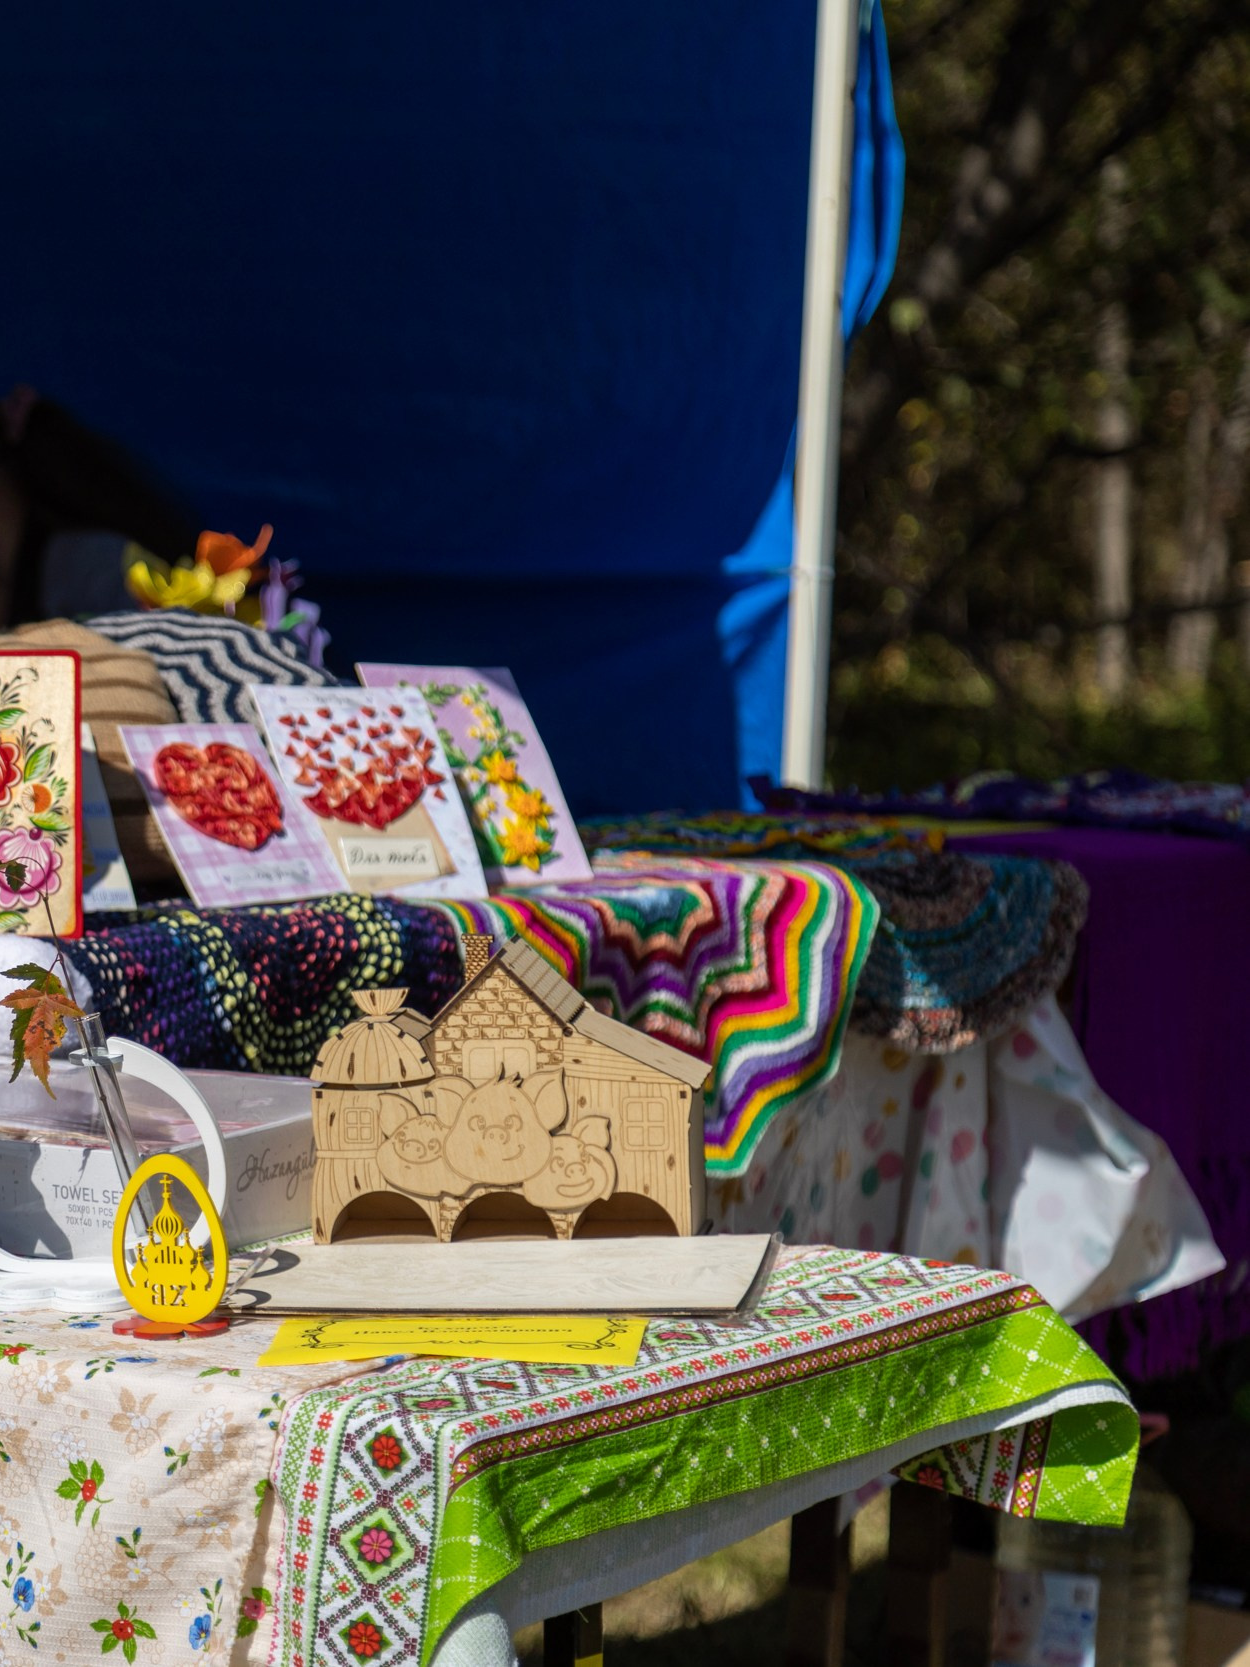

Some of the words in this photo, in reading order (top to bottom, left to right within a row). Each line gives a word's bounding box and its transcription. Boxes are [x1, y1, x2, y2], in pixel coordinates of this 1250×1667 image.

[236, 1136, 317, 1201] Hazangül
[52, 1184, 99, 1203] TOWEL
[98, 1207, 114, 1217] PCS
[102, 1219, 115, 1230] PC
